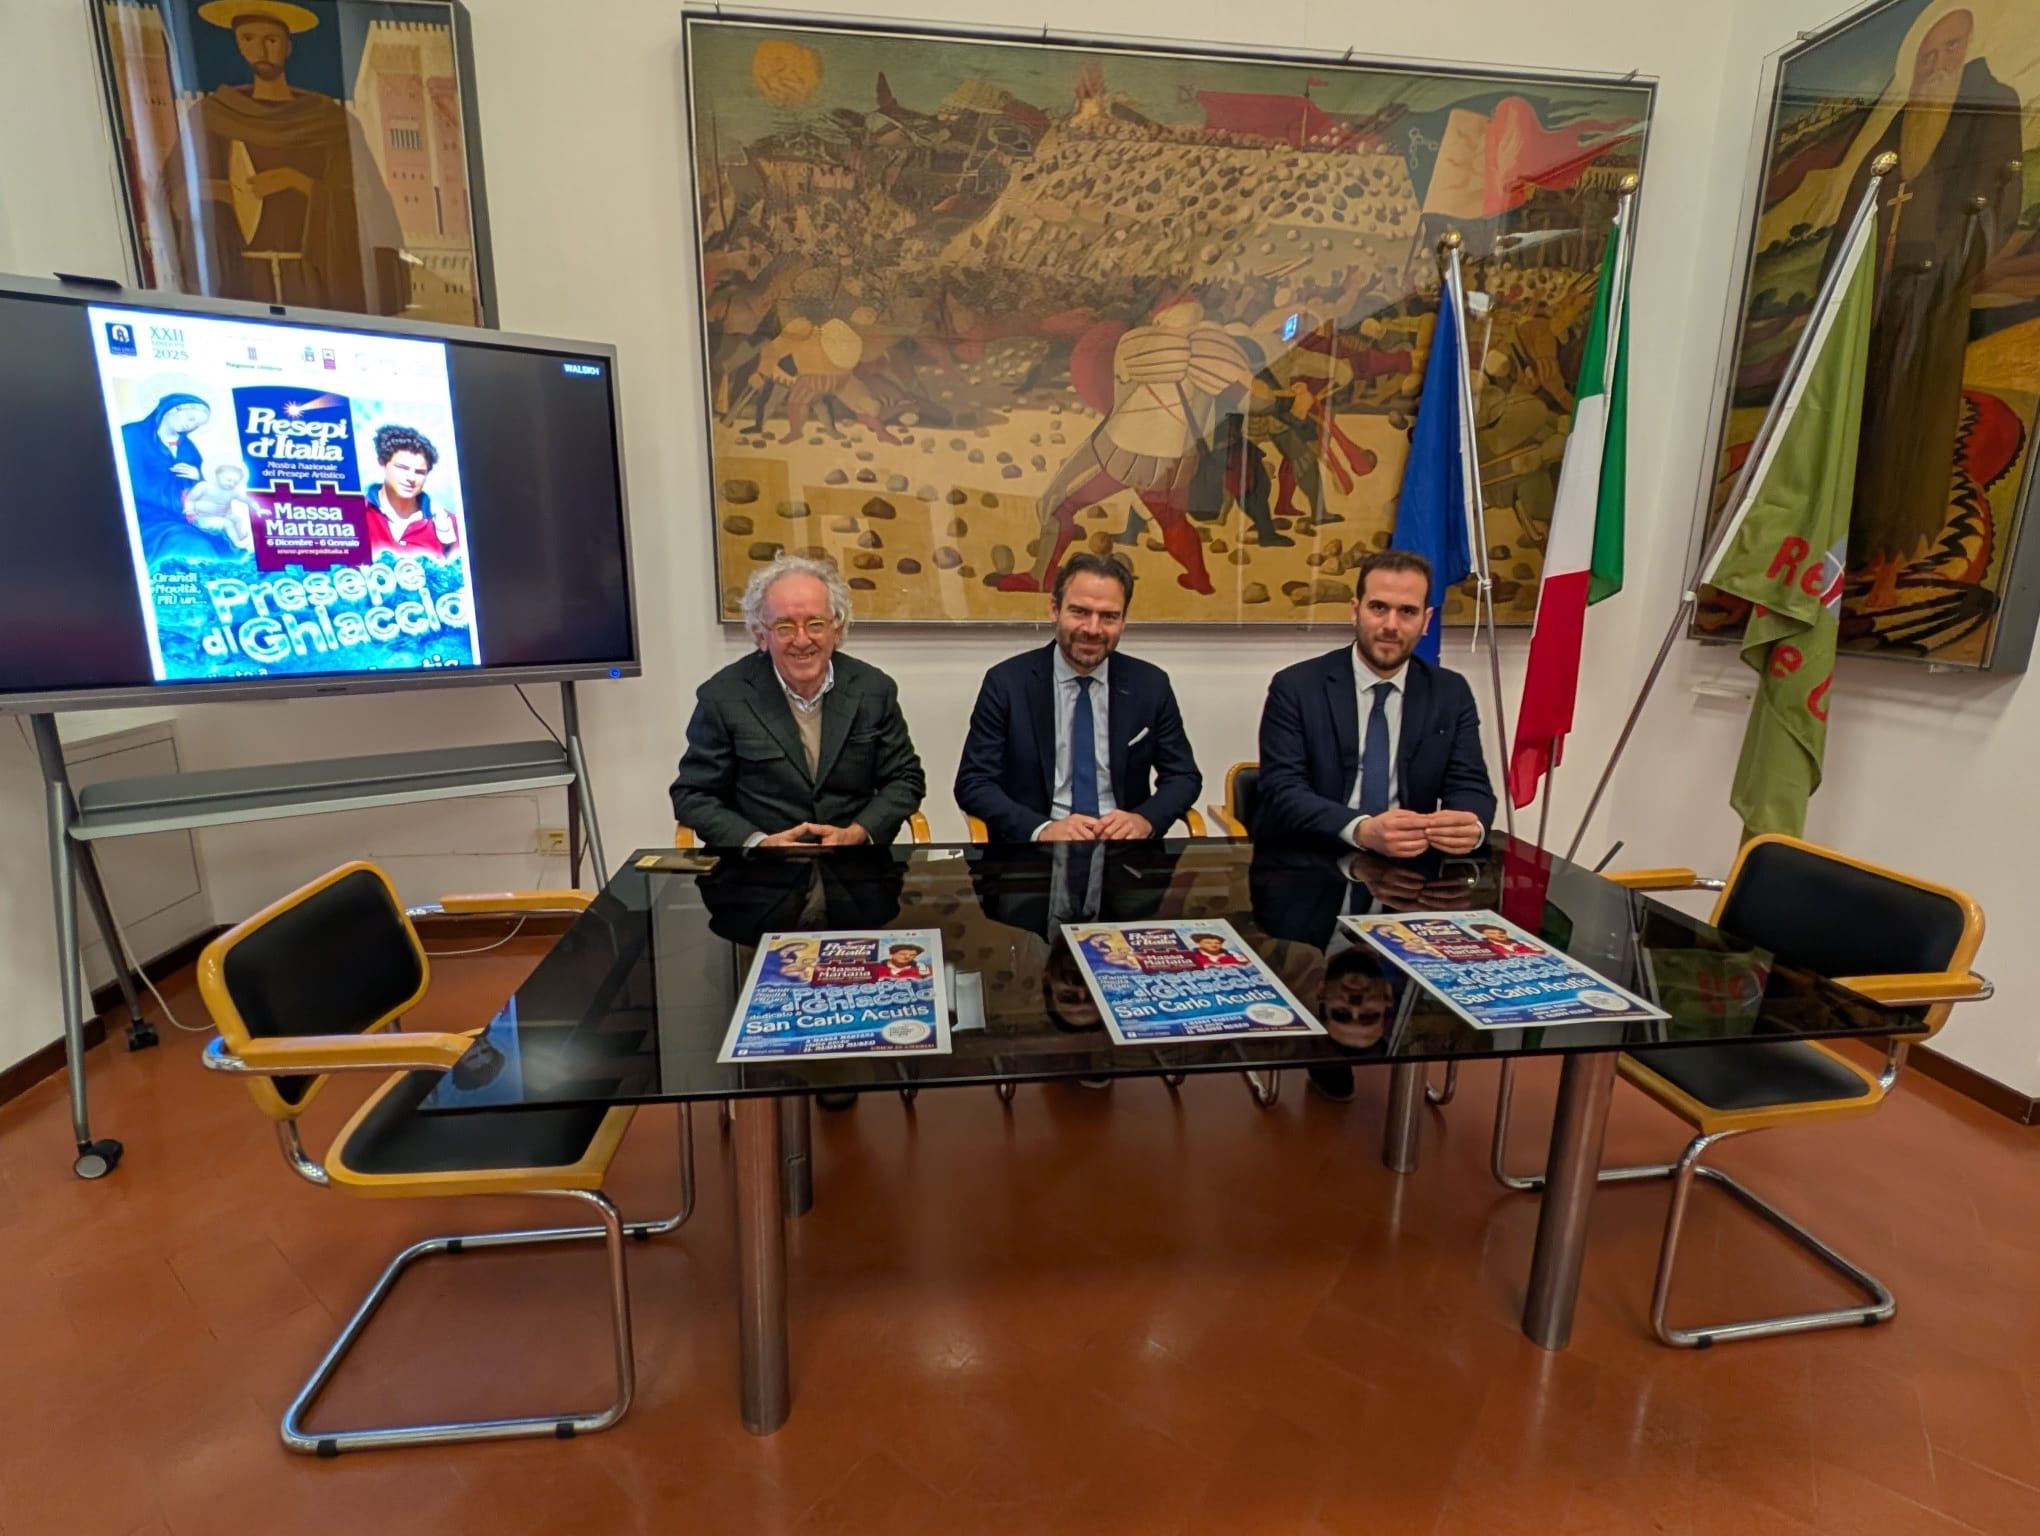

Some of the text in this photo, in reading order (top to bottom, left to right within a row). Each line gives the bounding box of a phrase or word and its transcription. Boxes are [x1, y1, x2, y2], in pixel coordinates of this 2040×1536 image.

[150, 326, 184, 342] XXII
[153, 348, 189, 361] 2025
[245, 406, 349, 442] Presepi
[246, 433, 344, 461] d'Italia
[262, 469, 346, 480] del Presepe Artistico
[267, 461, 338, 471] Mostra Nazionale
[273, 502, 343, 521] Massa
[265, 519, 356, 537] Martana
[266, 539, 274, 547] 6
[275, 539, 313, 547] Dicembre
[327, 540, 360, 548] Gennaio
[153, 572, 197, 582] Grandi
[205, 557, 426, 626] Presepe
[202, 587, 469, 663] di Ghiaccio
[1451, 992, 1495, 1005] San
[1493, 985, 1540, 1000] Carlo
[1543, 977, 1597, 992] Acutis
[1114, 1005, 1157, 1018] San
[1158, 998, 1212, 1013] Carlo
[1216, 989, 1277, 1005] Acutis
[746, 1004, 929, 1034] San Carlo Acutis
